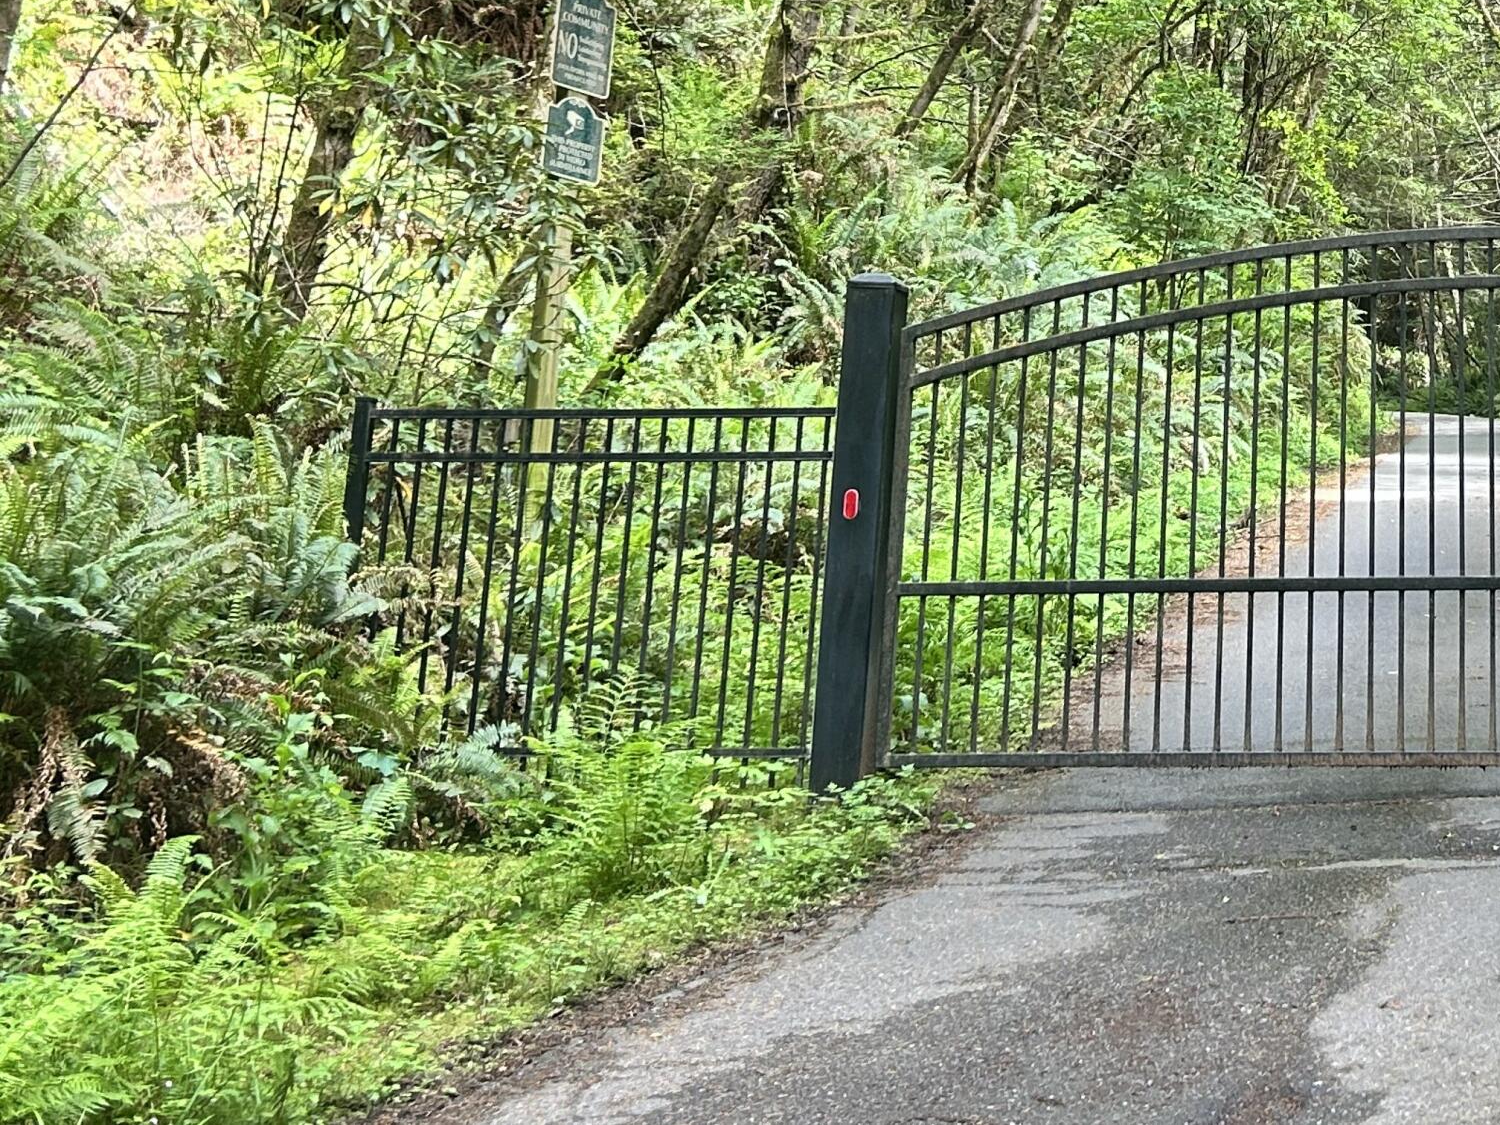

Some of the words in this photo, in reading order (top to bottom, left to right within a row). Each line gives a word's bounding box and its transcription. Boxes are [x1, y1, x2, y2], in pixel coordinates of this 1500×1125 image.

[573, 0, 602, 20] PRIVATE
[562, 11, 609, 35] COMMUNITY
[557, 29, 578, 59] NO
